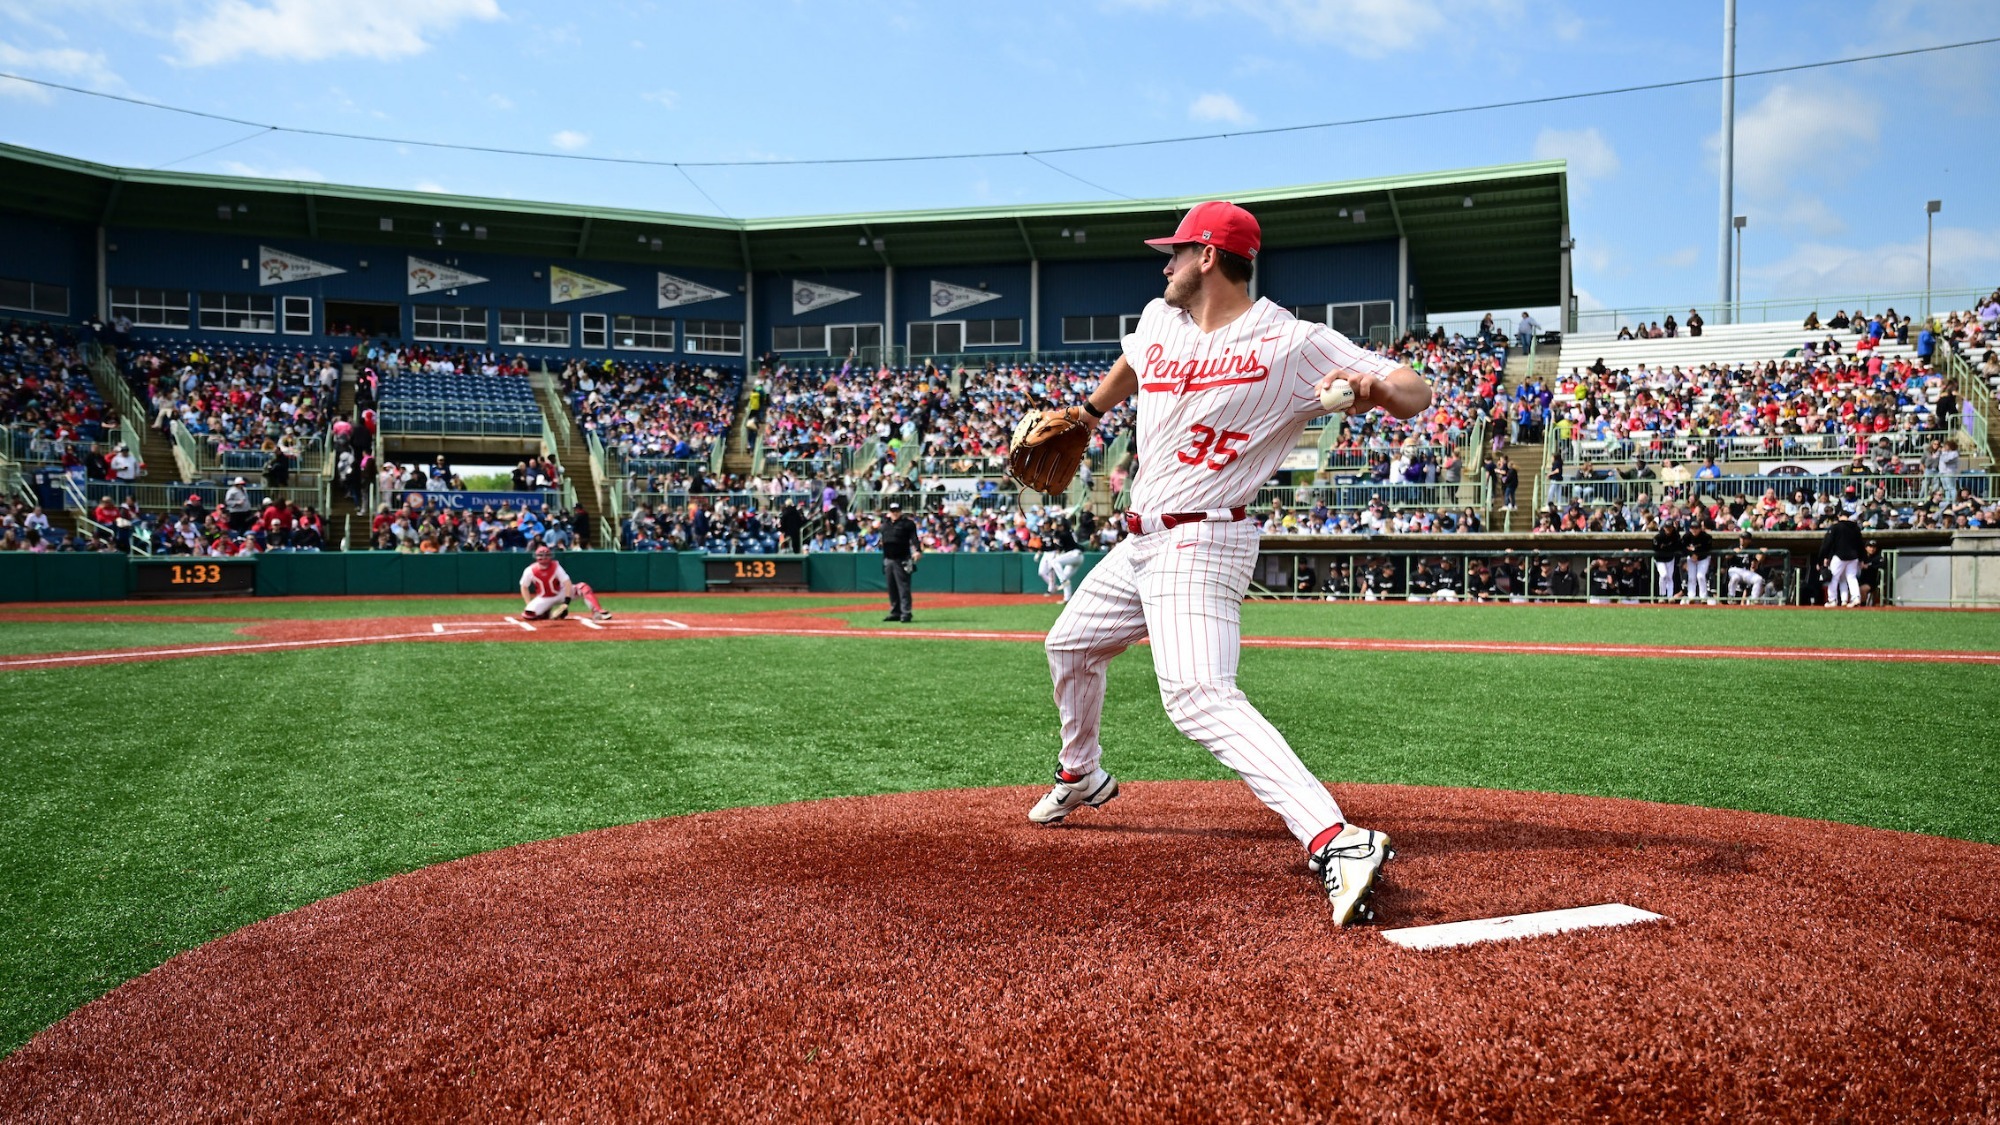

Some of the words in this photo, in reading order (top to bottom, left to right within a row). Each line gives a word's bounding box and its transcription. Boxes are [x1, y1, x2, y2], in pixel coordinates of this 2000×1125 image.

[1141, 343, 1261, 396] Penguins
[1177, 423, 1250, 471] 35
[426, 493, 464, 508] PNC
[472, 497, 515, 505] DIAMOD
[171, 564, 221, 584] 1:33
[734, 560, 776, 578] 1:33
